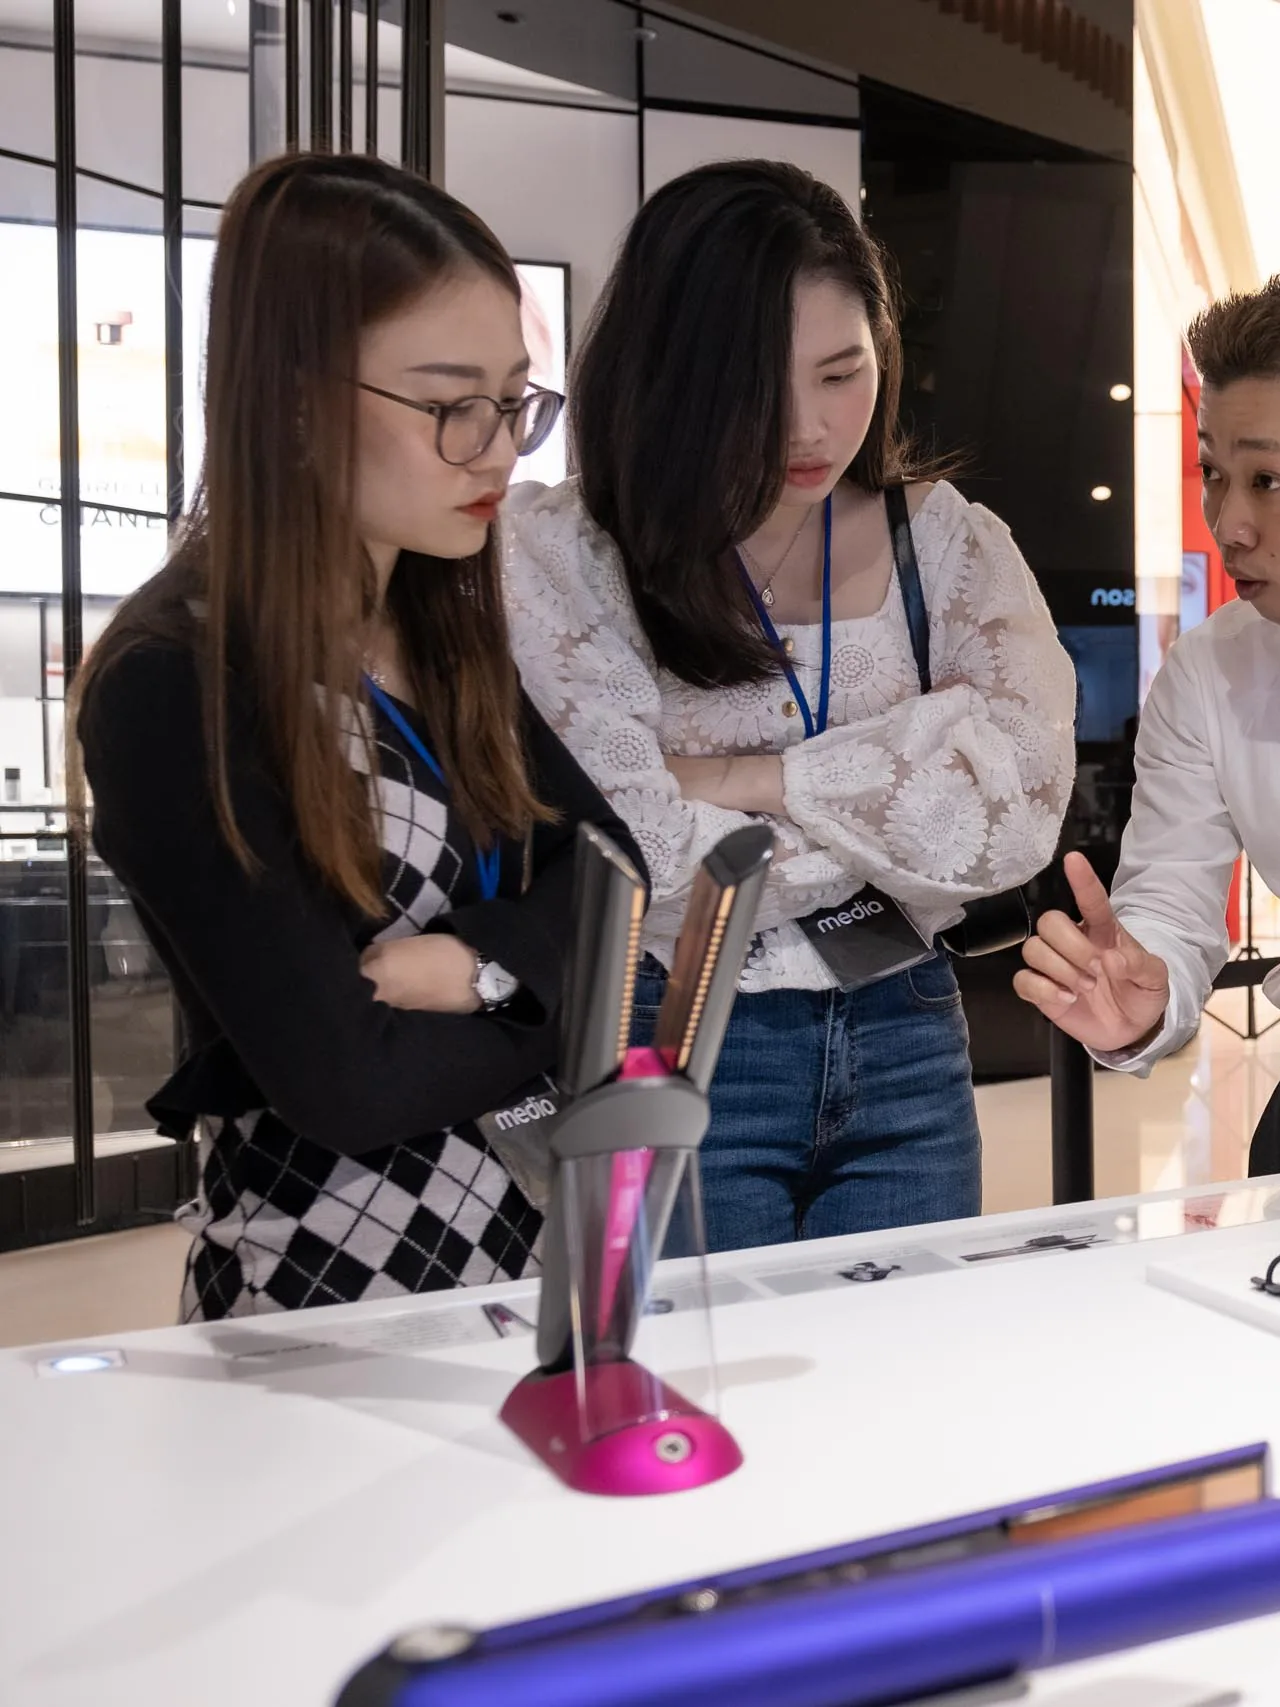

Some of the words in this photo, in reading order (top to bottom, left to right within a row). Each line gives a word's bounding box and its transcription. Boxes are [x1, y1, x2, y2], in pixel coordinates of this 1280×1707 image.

[39, 503, 163, 529] CANE
[817, 901, 884, 933] media
[494, 1096, 558, 1131] media
